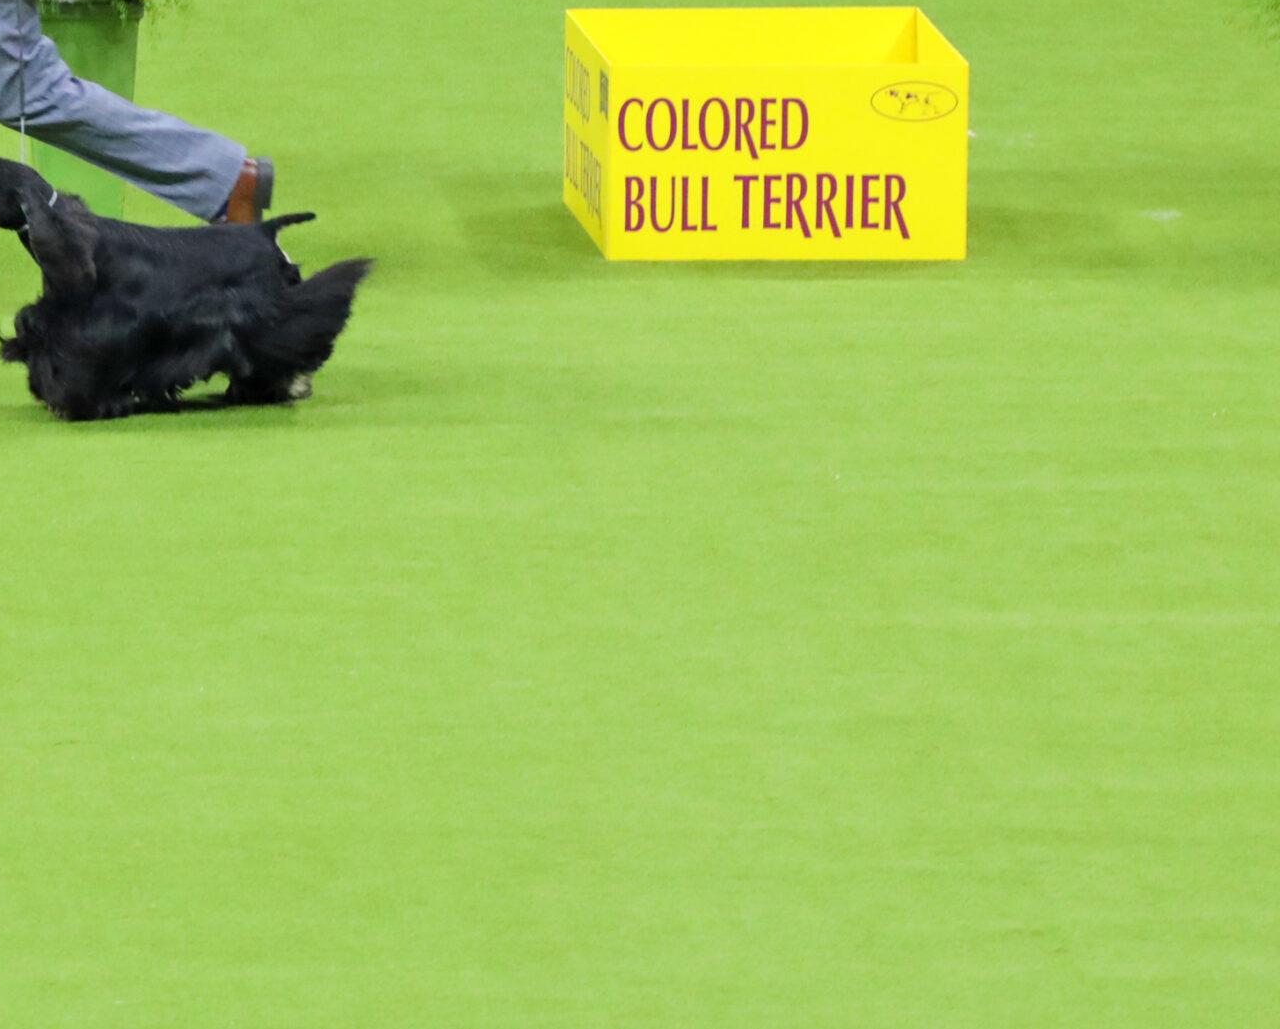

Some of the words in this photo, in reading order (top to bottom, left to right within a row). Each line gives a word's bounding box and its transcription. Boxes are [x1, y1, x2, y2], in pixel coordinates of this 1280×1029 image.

[617, 97, 809, 160] COLORED
[624, 176, 718, 233] BULL
[733, 173, 910, 240] TERRIER
